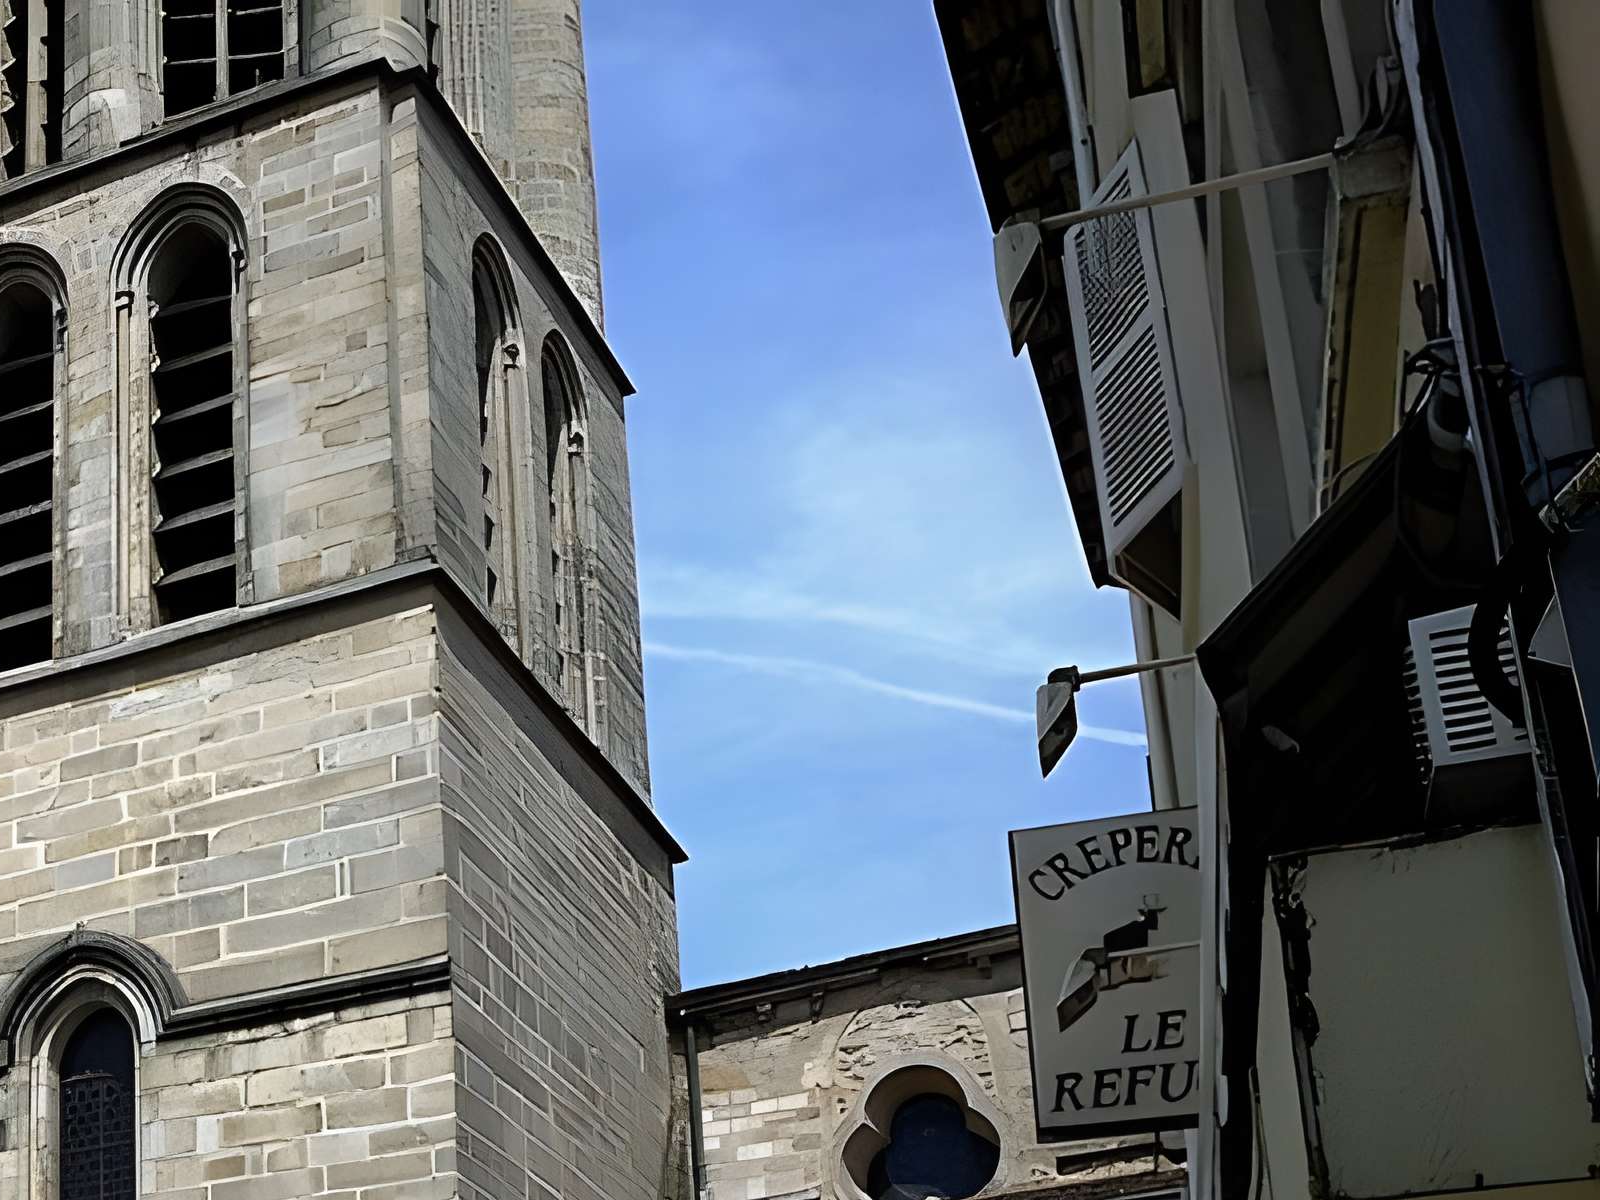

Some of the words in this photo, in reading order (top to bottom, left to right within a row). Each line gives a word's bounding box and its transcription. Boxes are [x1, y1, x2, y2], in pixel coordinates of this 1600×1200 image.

[1028, 825, 1199, 901] CREPER
[1121, 1010, 1186, 1054] LE
[1051, 1060, 1199, 1113] REFU
